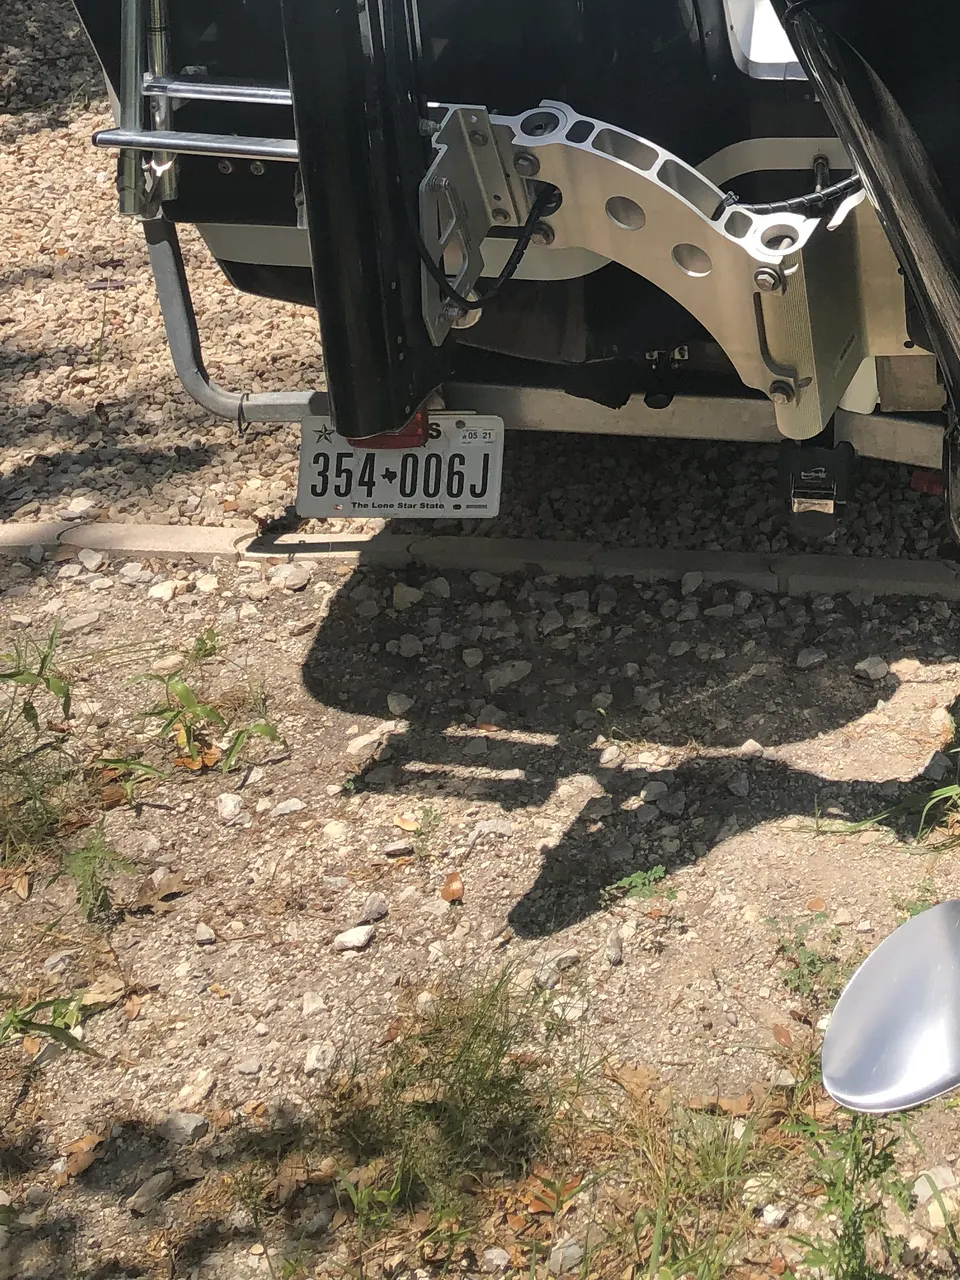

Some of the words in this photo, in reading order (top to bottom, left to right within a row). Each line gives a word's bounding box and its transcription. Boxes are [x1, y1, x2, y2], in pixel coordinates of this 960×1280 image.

[310, 452, 376, 498] 354
[399, 452, 490, 498] 006J
[351, 501, 369, 509] The
[371, 501, 395, 509] Lone
[397, 501, 417, 509] Star
[419, 501, 445, 509] State
